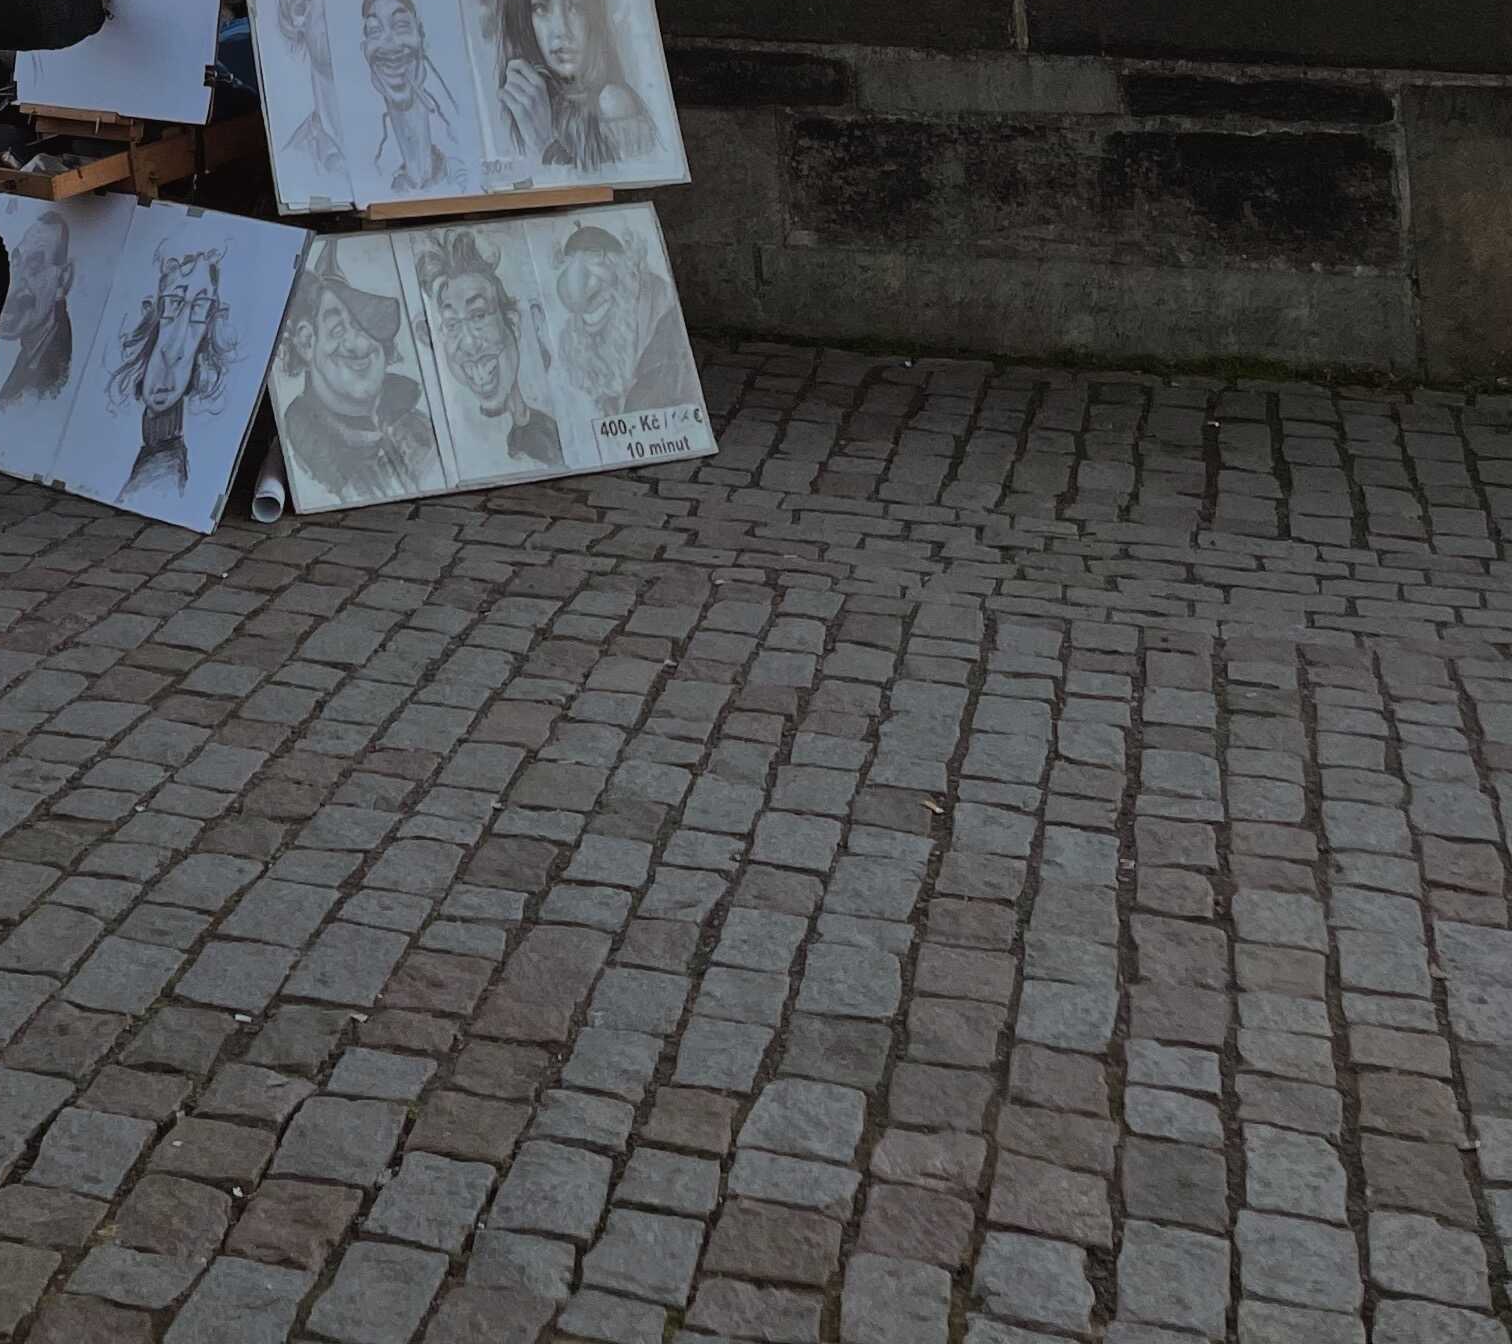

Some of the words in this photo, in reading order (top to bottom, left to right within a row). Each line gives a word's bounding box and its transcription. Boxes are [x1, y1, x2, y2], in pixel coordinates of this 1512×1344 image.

[600, 419, 636, 438] 400,-
[627, 441, 645, 459] 10
[649, 435, 691, 456] minut
